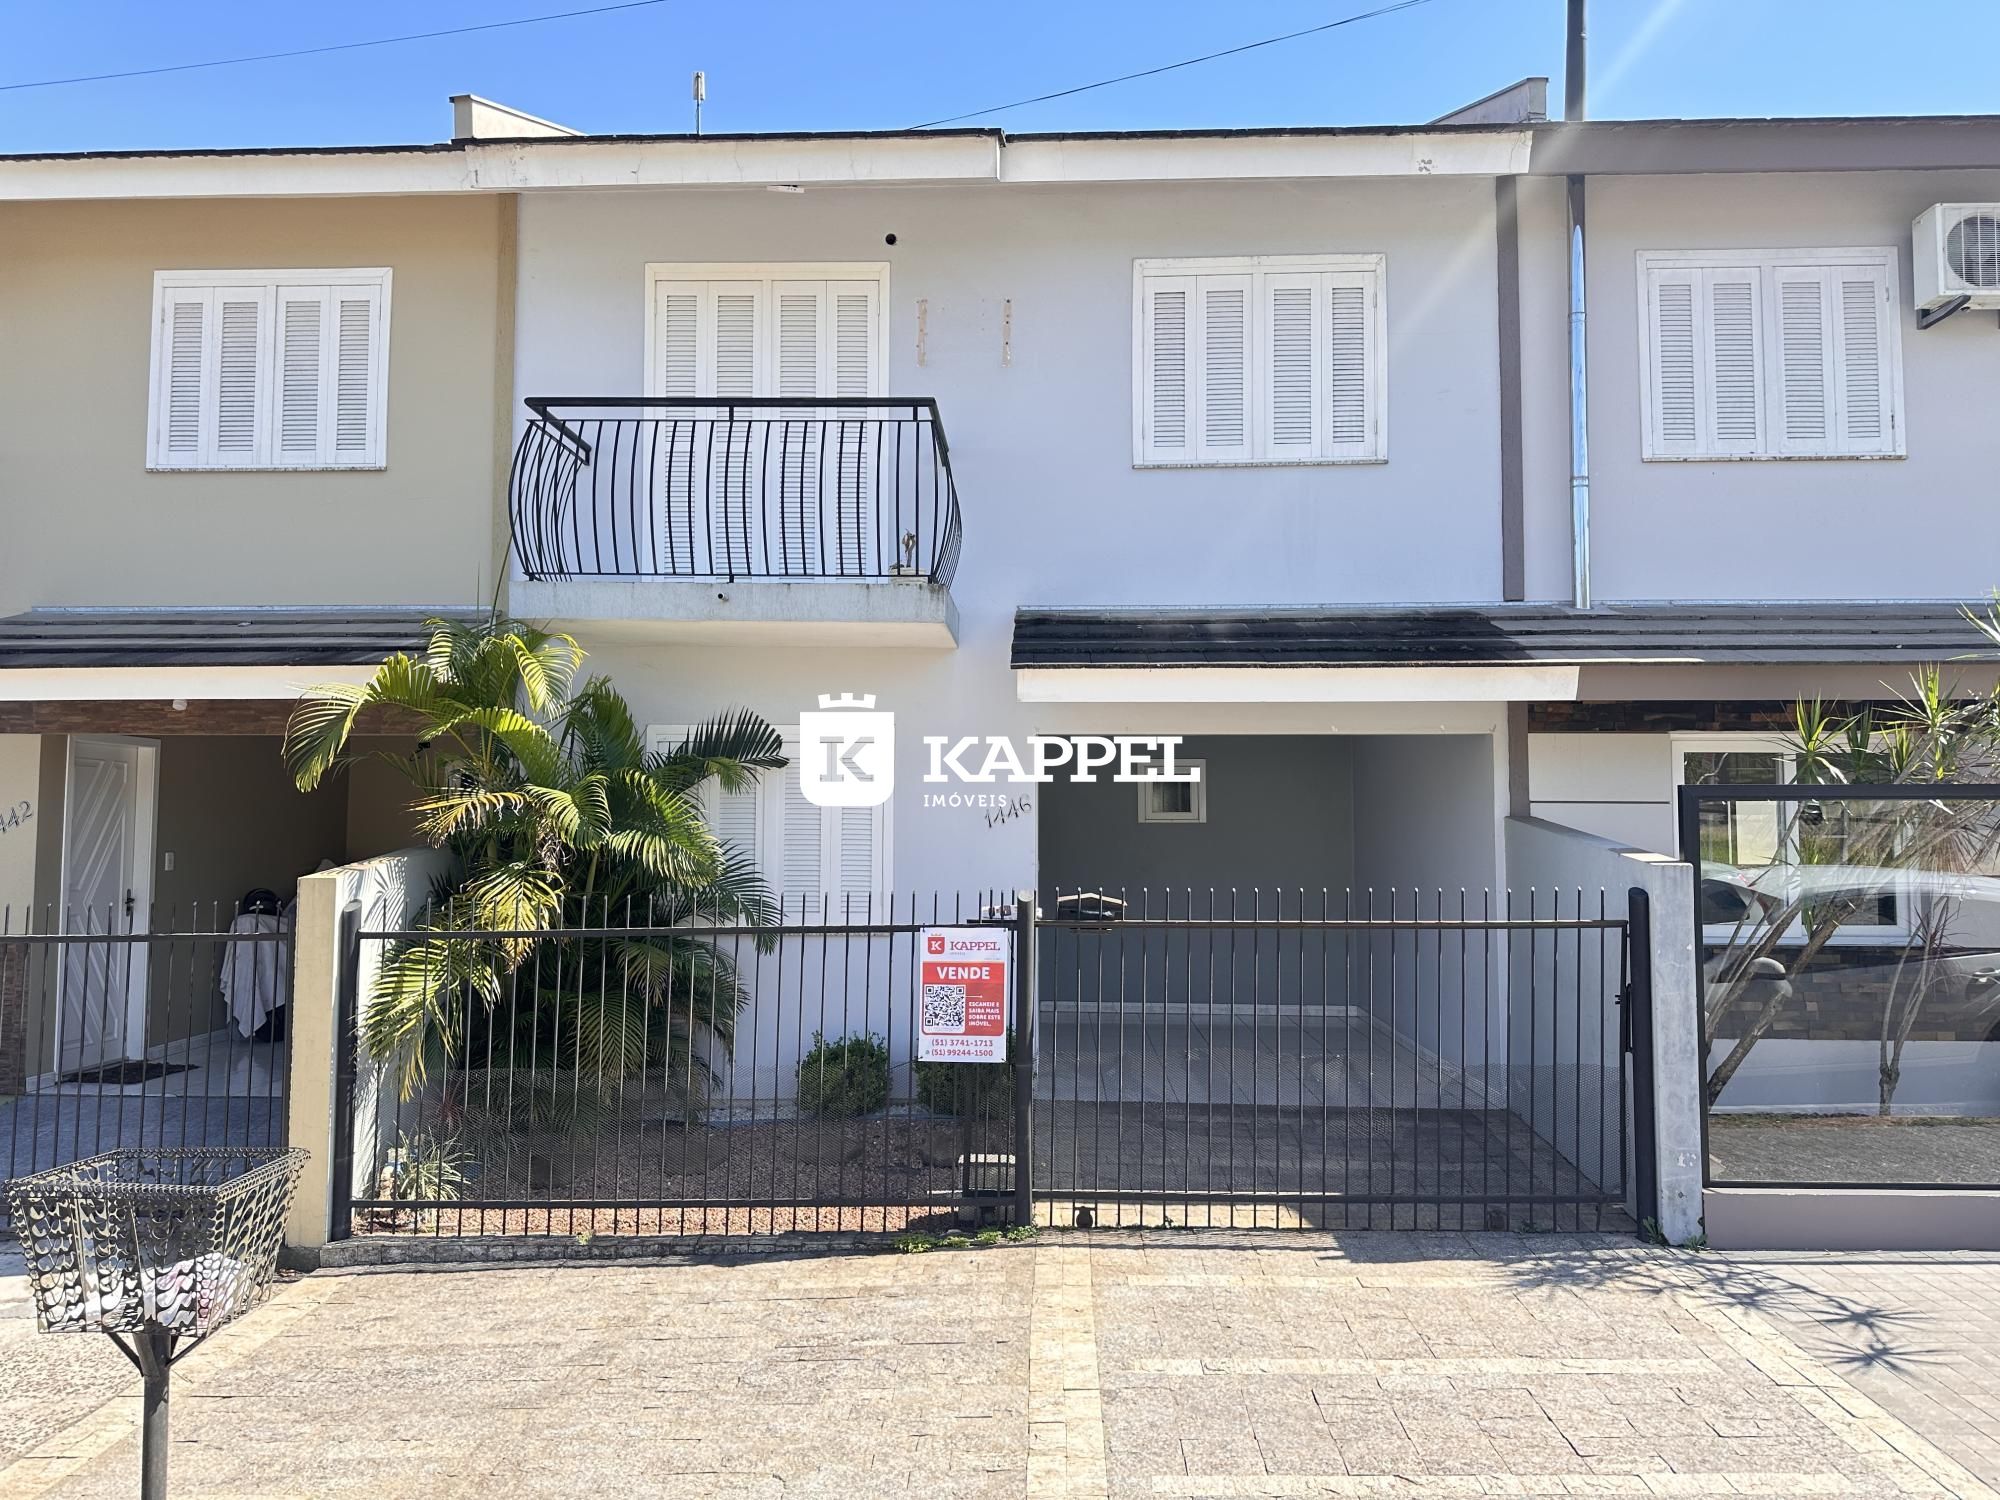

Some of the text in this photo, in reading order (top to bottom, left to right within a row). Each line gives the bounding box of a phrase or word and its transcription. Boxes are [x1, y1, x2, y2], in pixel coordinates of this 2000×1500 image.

[984, 793, 1032, 829] 1446
[931, 940, 1001, 951] K KAPPEL
[936, 966, 991, 980] VENDE
[931, 1039, 994, 1047] (51) 3741-1713
[931, 1049, 994, 1057] (51) 99244-1500
